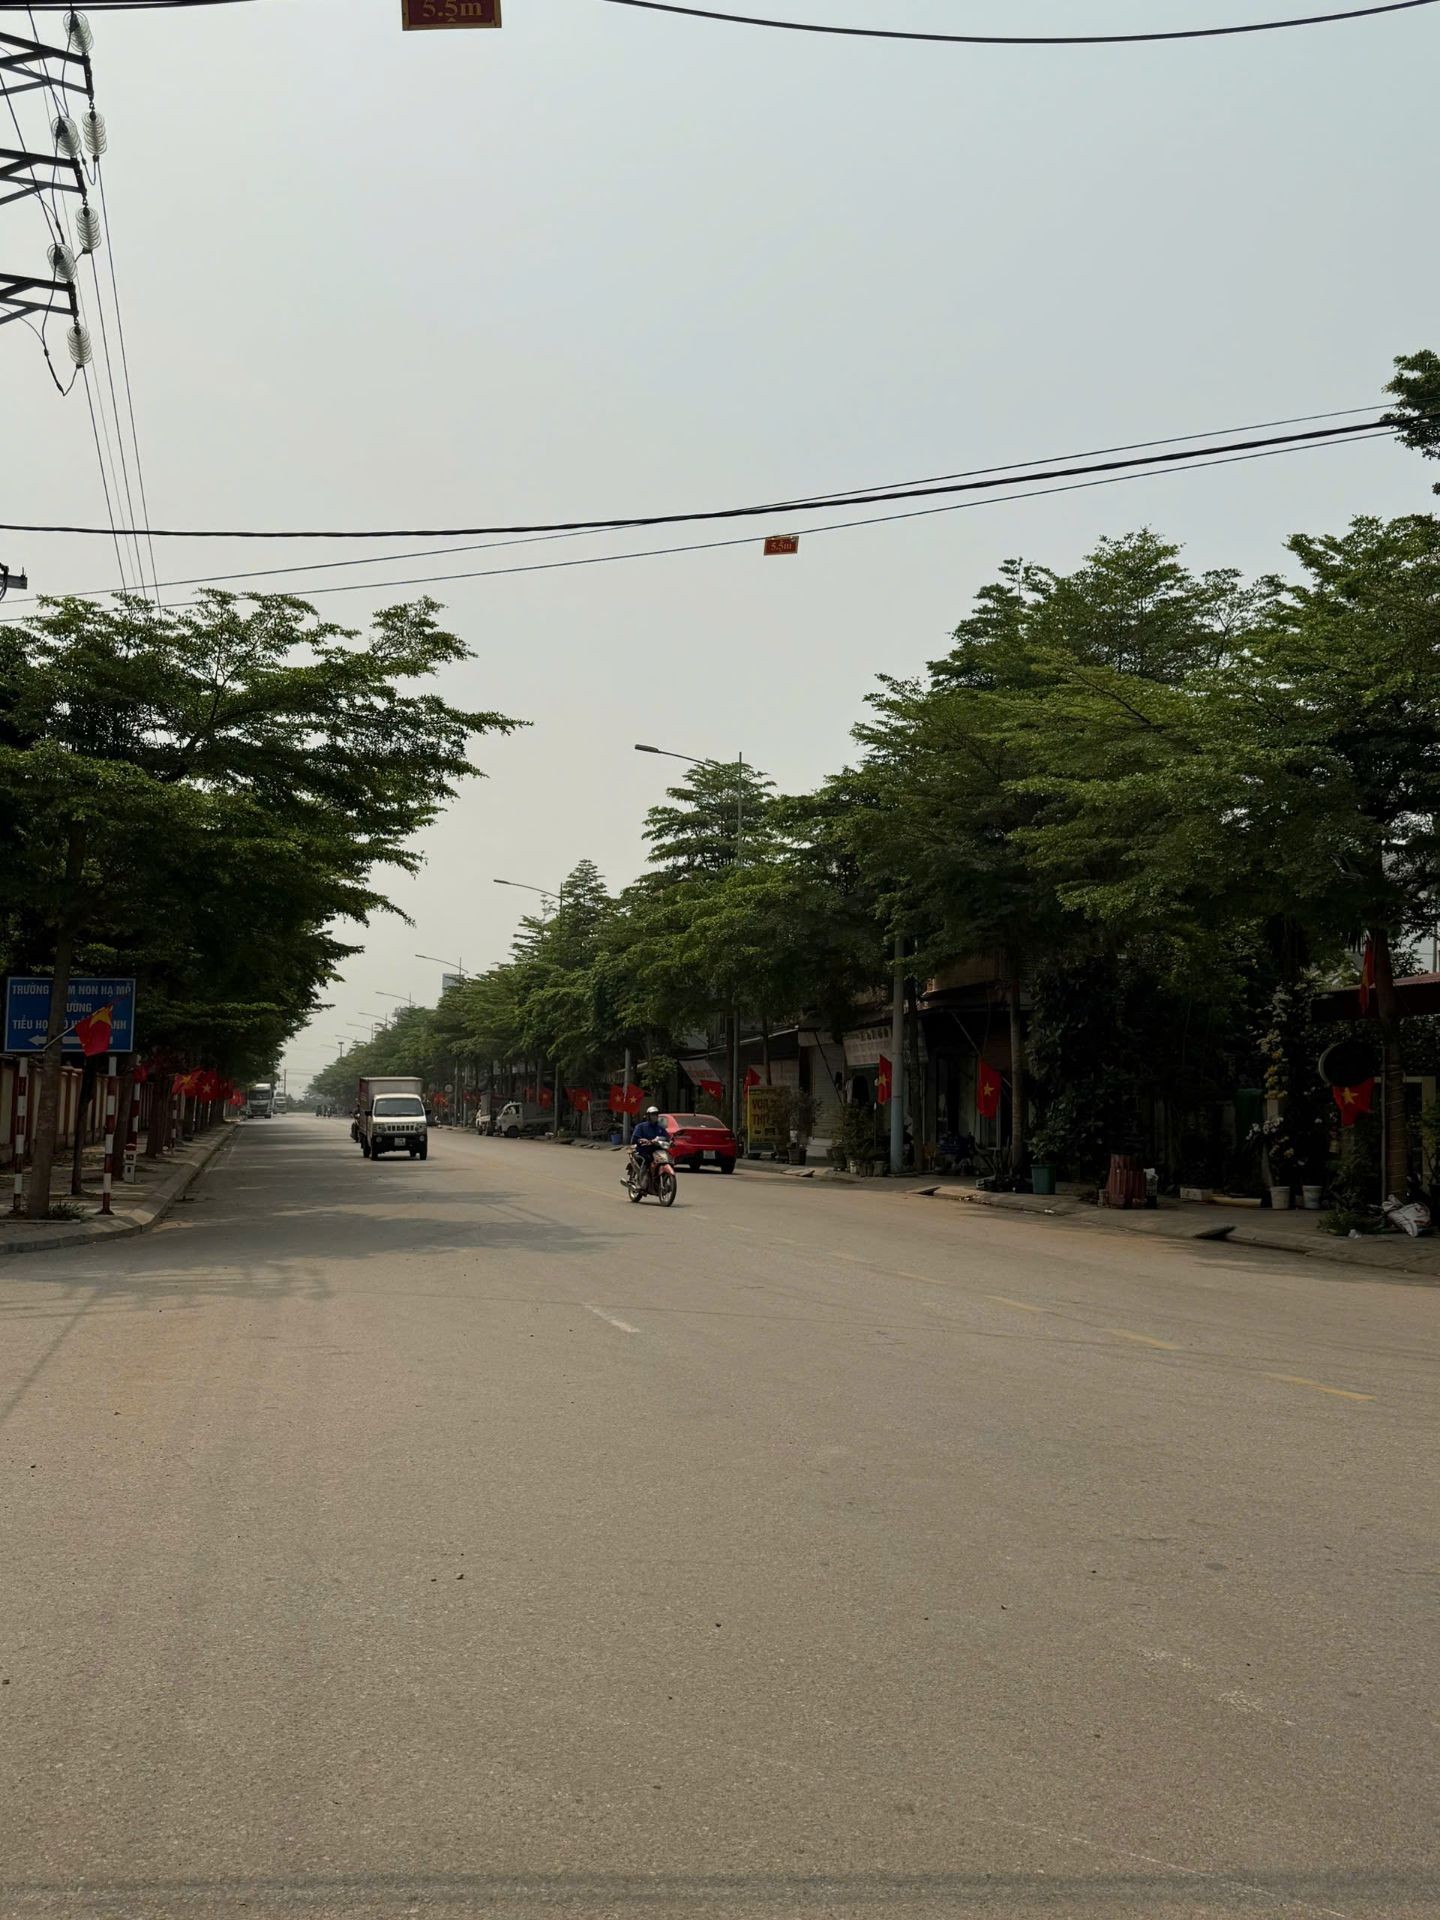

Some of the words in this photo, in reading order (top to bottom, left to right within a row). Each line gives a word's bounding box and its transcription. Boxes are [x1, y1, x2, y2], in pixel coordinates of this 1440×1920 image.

[423, 0, 482, 17] 5.5m
[12, 982, 49, 995] TRƯỜNG
[78, 985, 98, 995] NON
[101, 985, 114, 998] HẠ
[12, 1014, 33, 1030] TIỂU
[35, 1019, 48, 1032] HỌ
